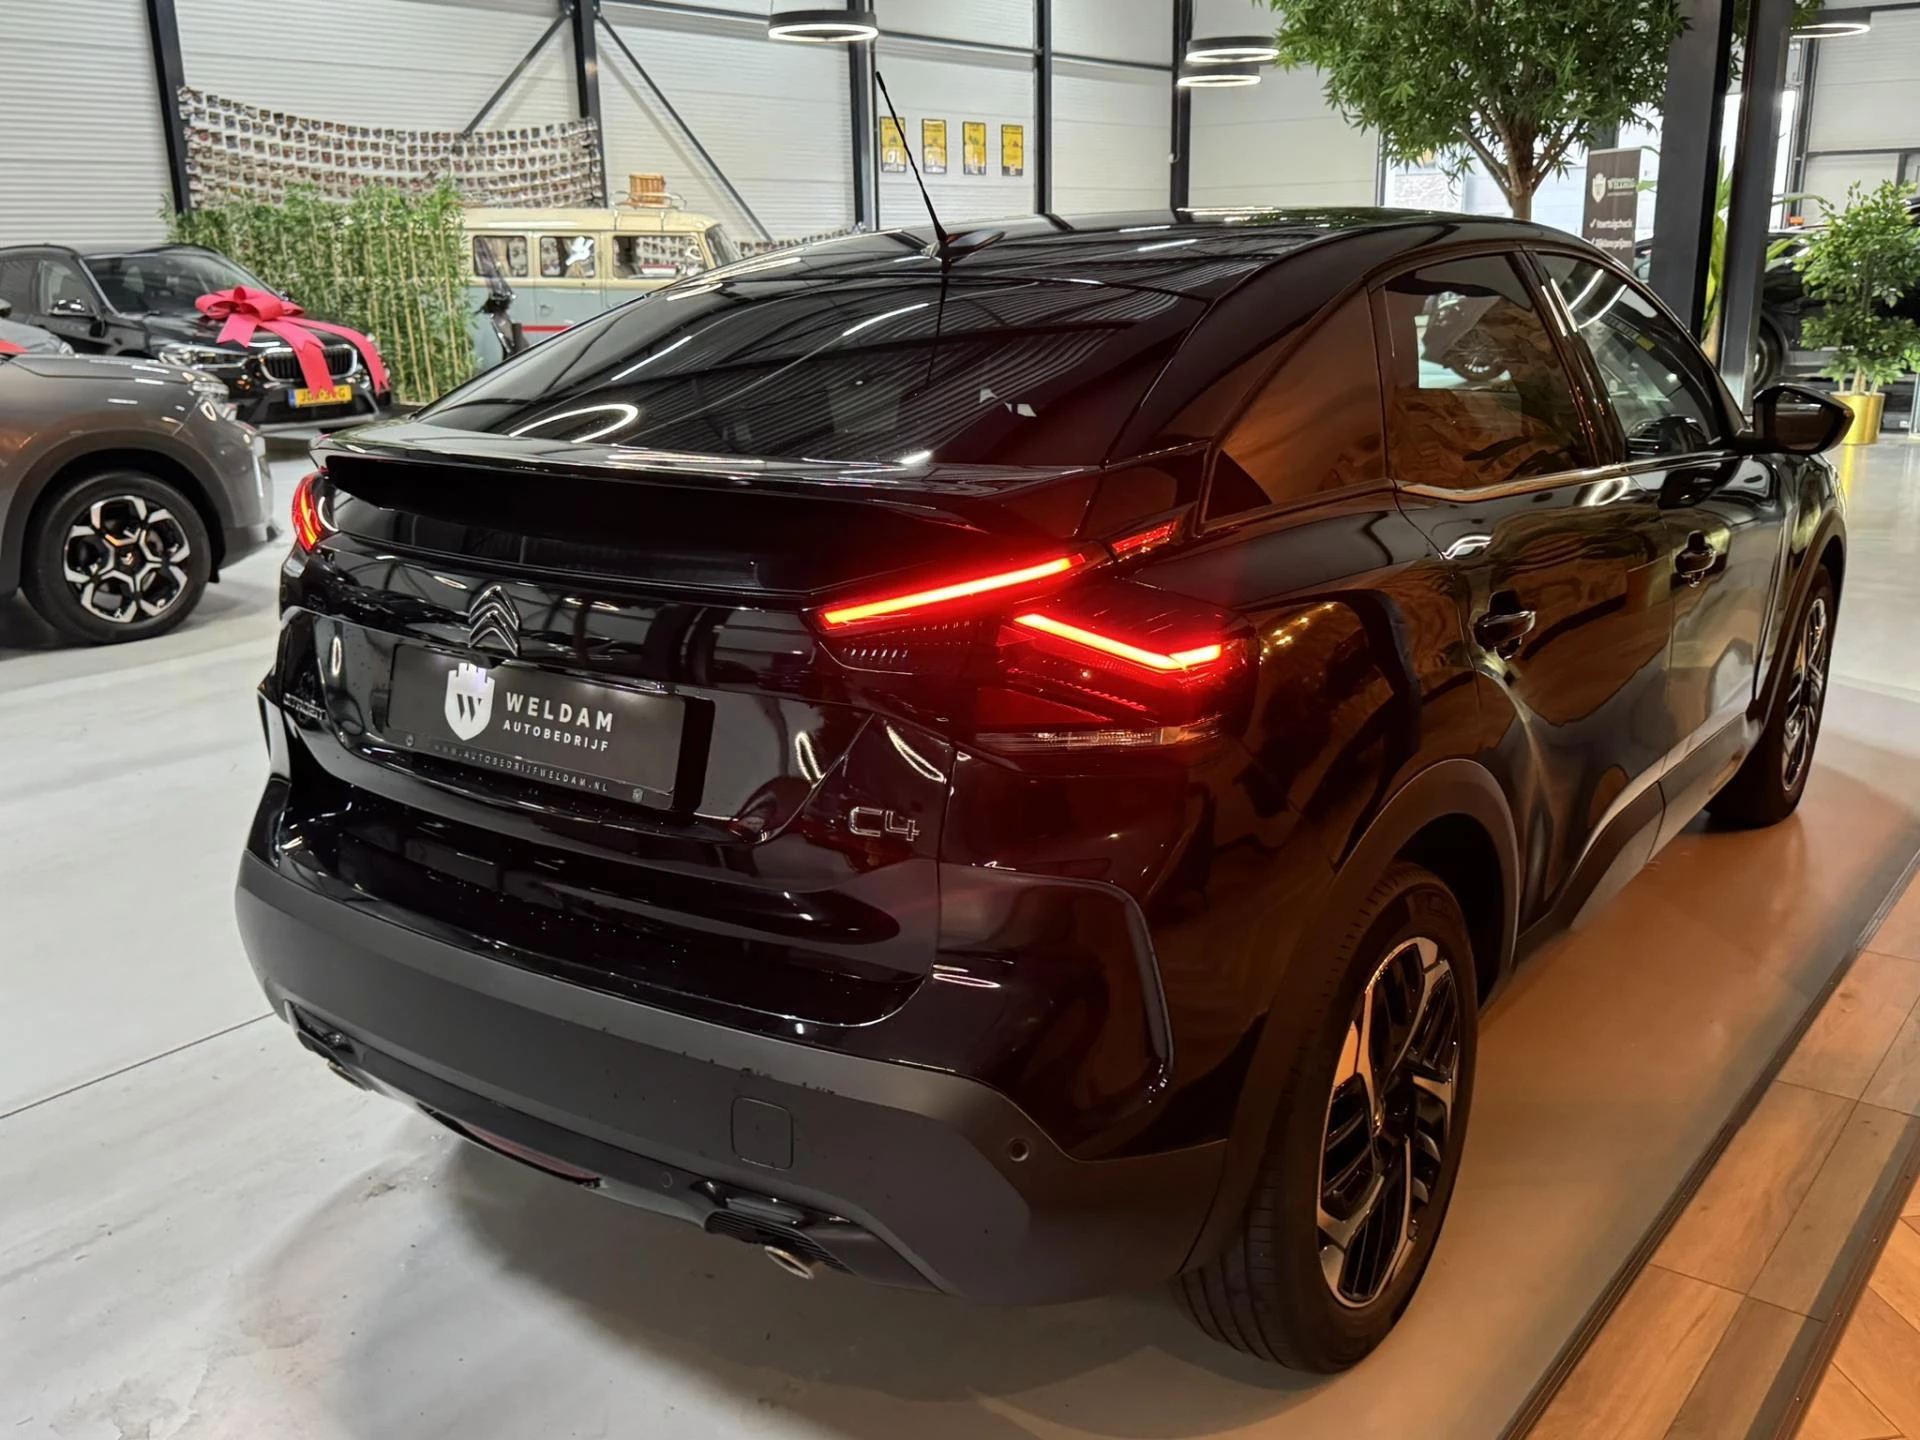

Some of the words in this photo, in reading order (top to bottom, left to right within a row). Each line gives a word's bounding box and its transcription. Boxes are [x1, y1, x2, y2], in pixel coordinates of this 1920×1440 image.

[456, 693, 482, 721] W
[506, 691, 613, 732] WELDAM
[503, 719, 609, 752] AUTOBEDRIJF
[849, 806, 920, 841] C4
